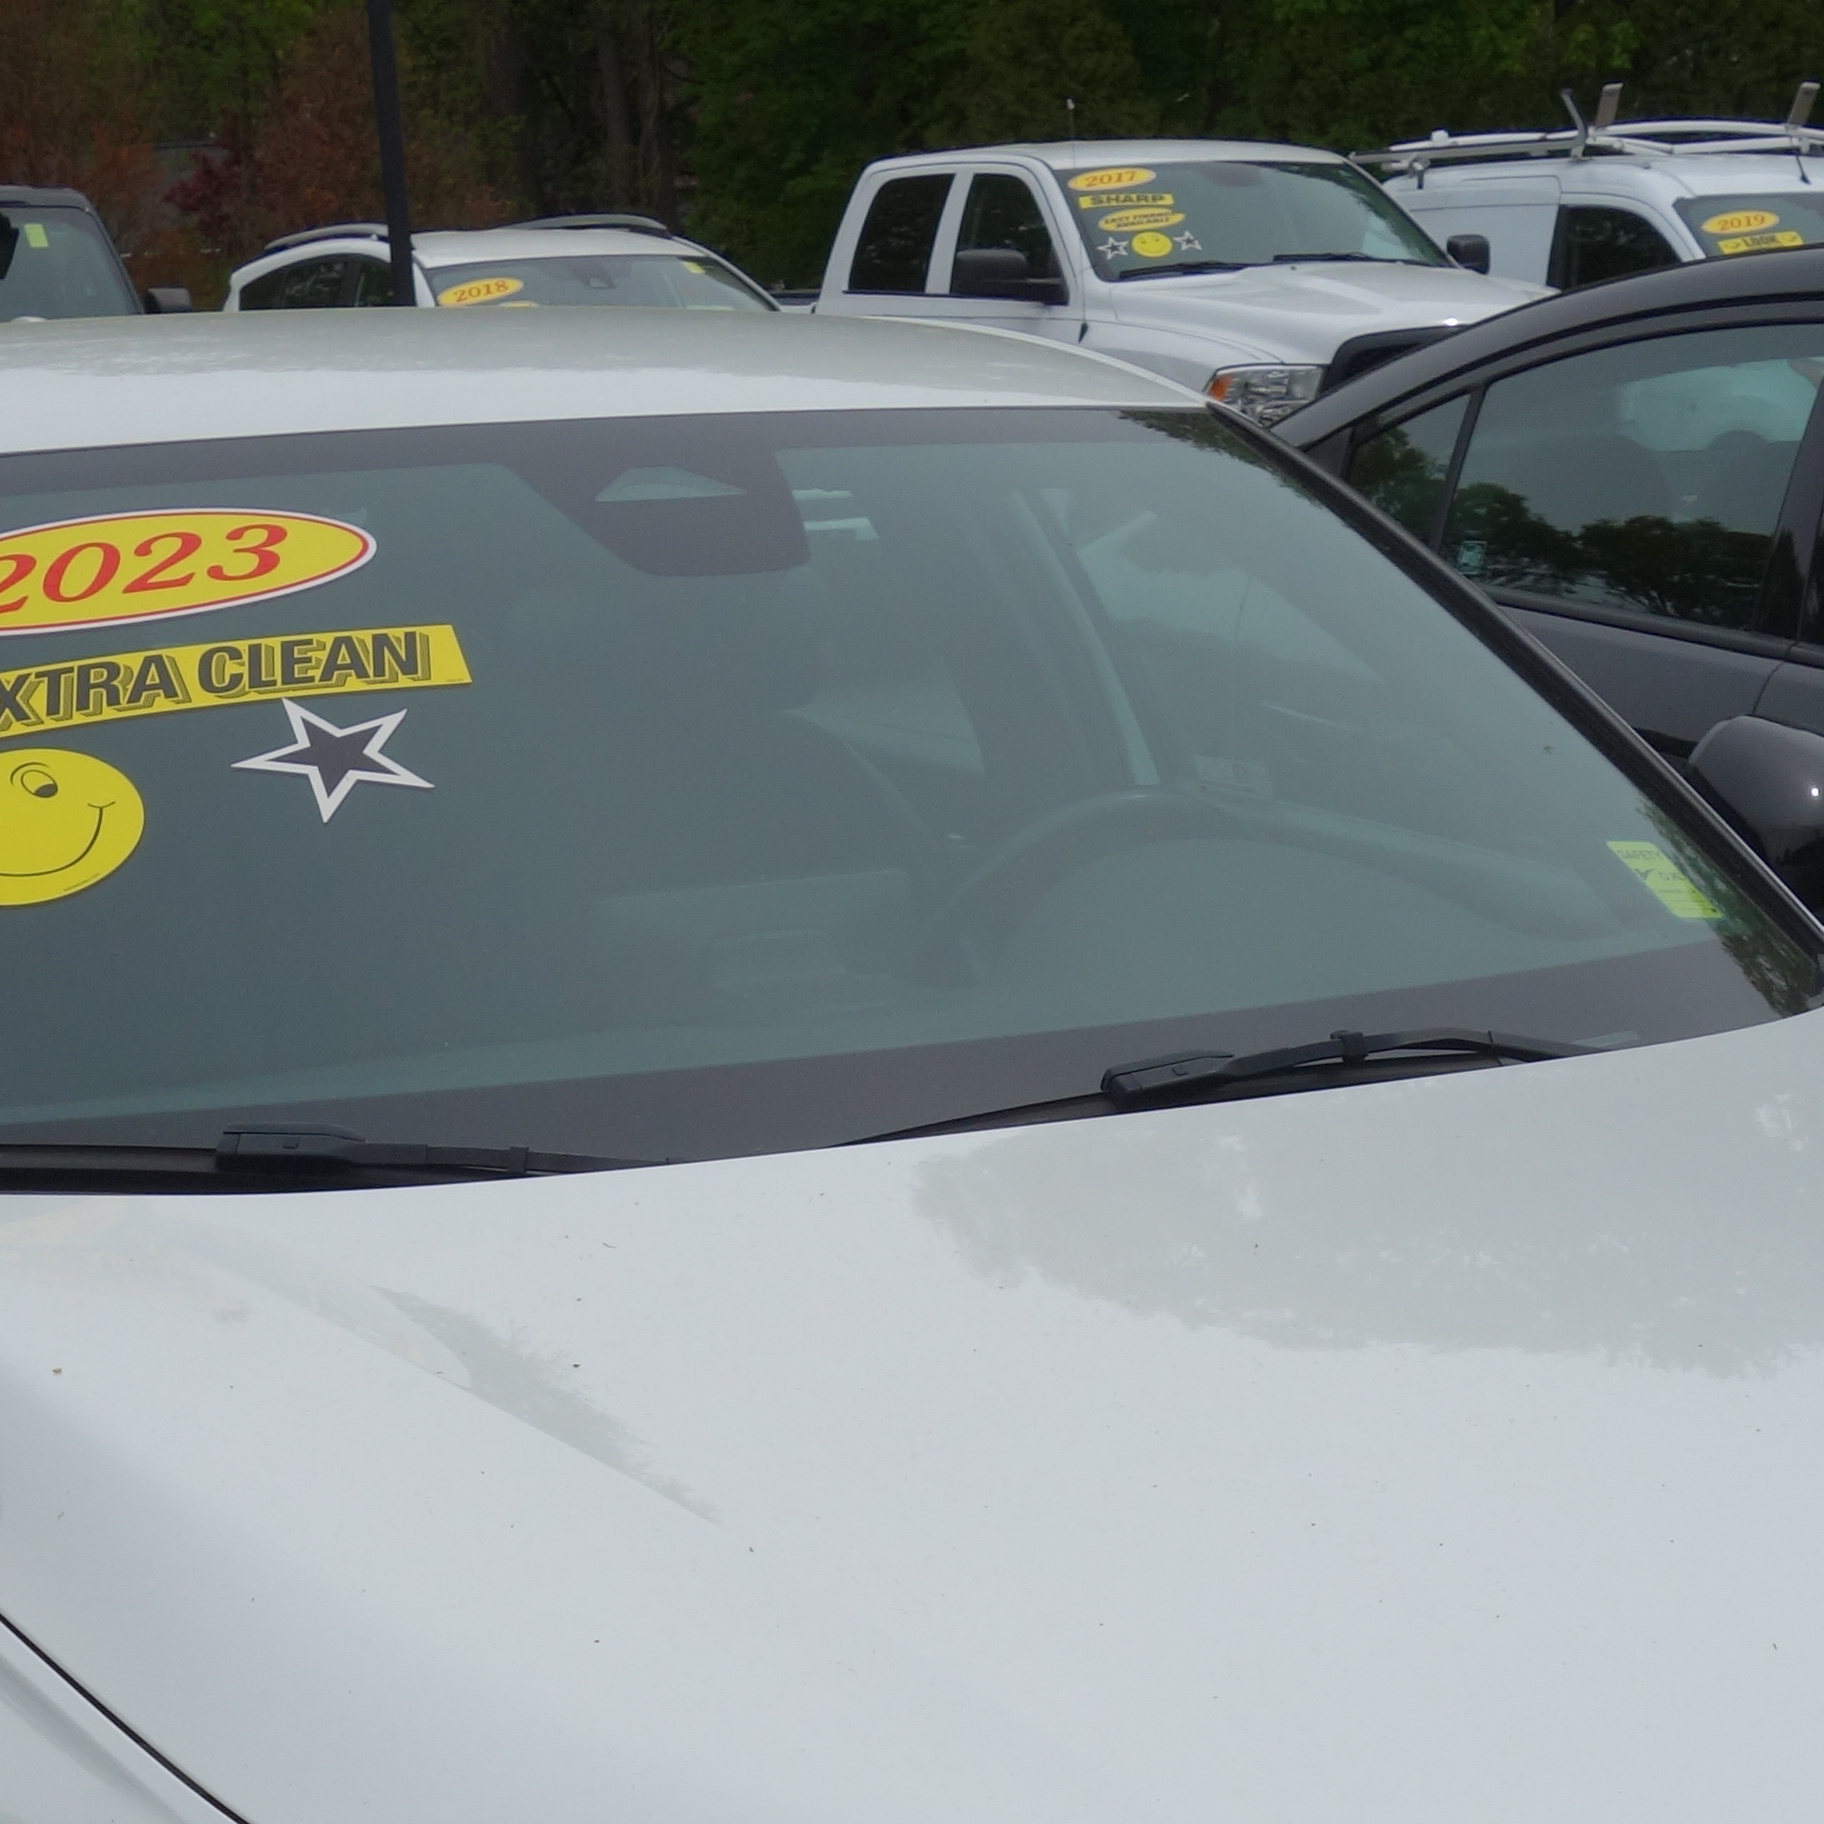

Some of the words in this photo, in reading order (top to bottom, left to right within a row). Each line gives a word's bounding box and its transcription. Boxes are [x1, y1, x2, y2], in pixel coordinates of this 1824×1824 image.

[1085, 170, 1137, 187] 2017
[1089, 193, 1167, 206] SHARP
[1717, 213, 1766, 231] 2019
[453, 279, 509, 302] 2018
[197, 630, 431, 698] CLEAN
